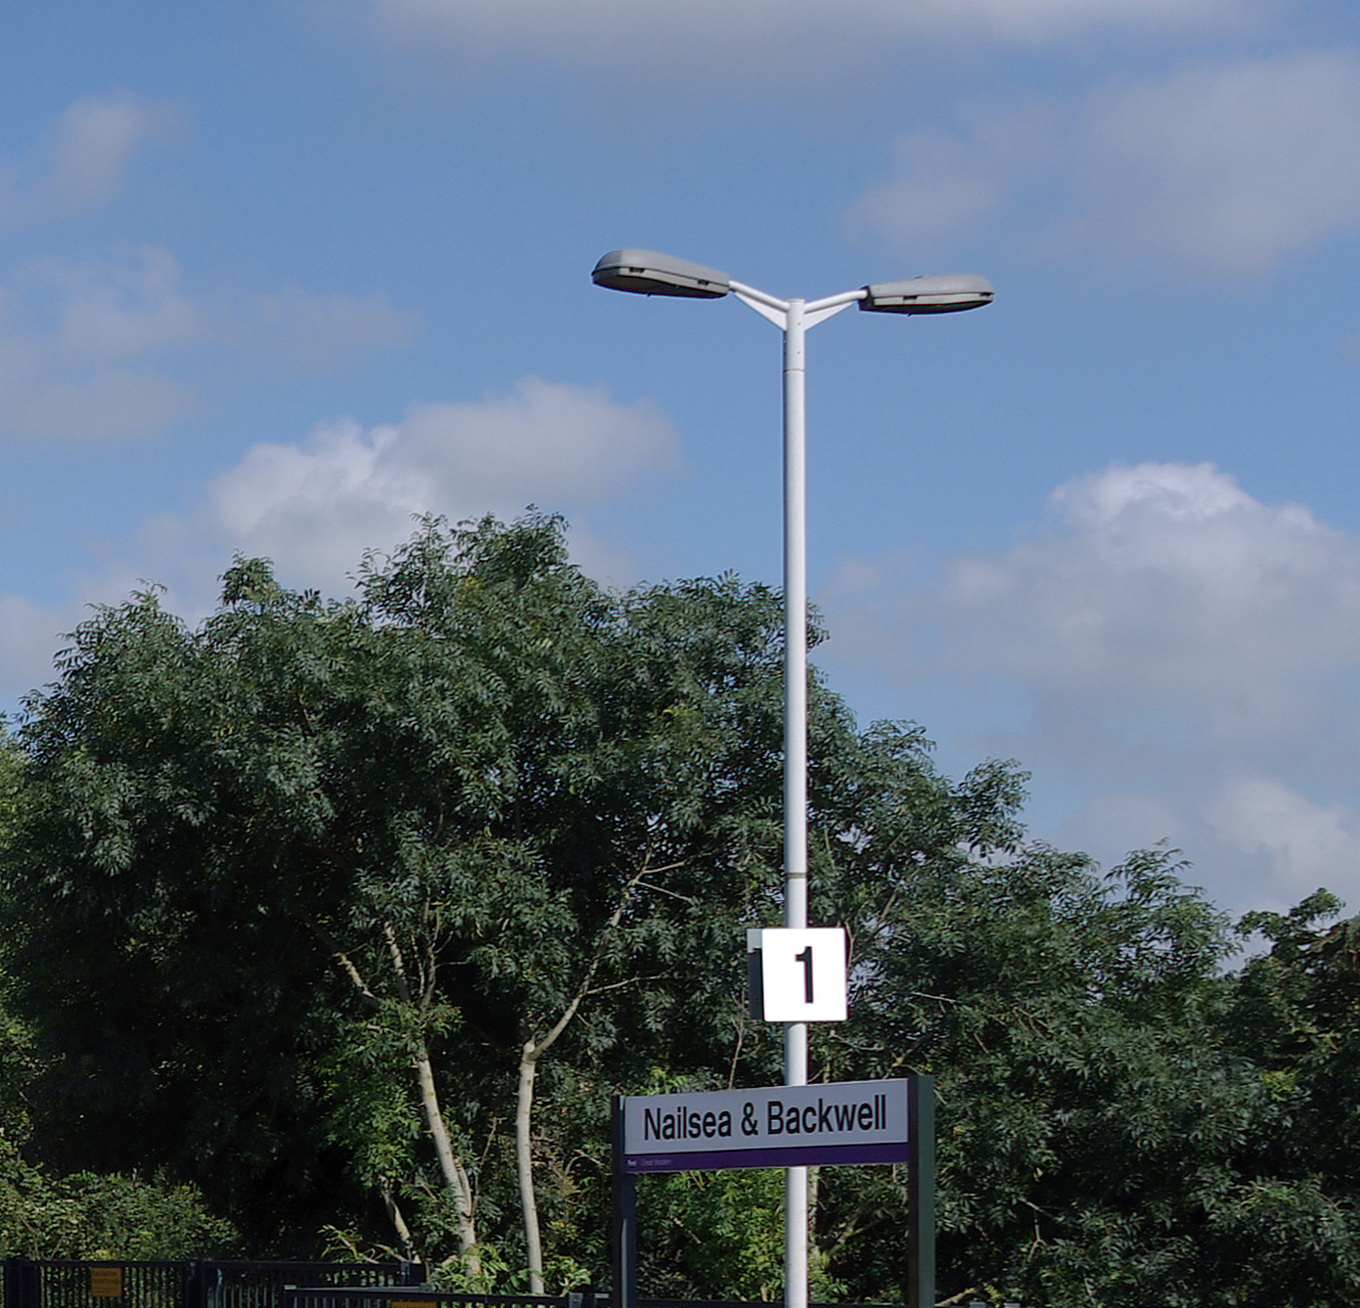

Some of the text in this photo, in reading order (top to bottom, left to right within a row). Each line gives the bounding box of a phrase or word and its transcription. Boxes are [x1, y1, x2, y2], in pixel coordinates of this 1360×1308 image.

[795, 946, 814, 1004] 1
[644, 1094, 886, 1141] Nailsea & Backwell
